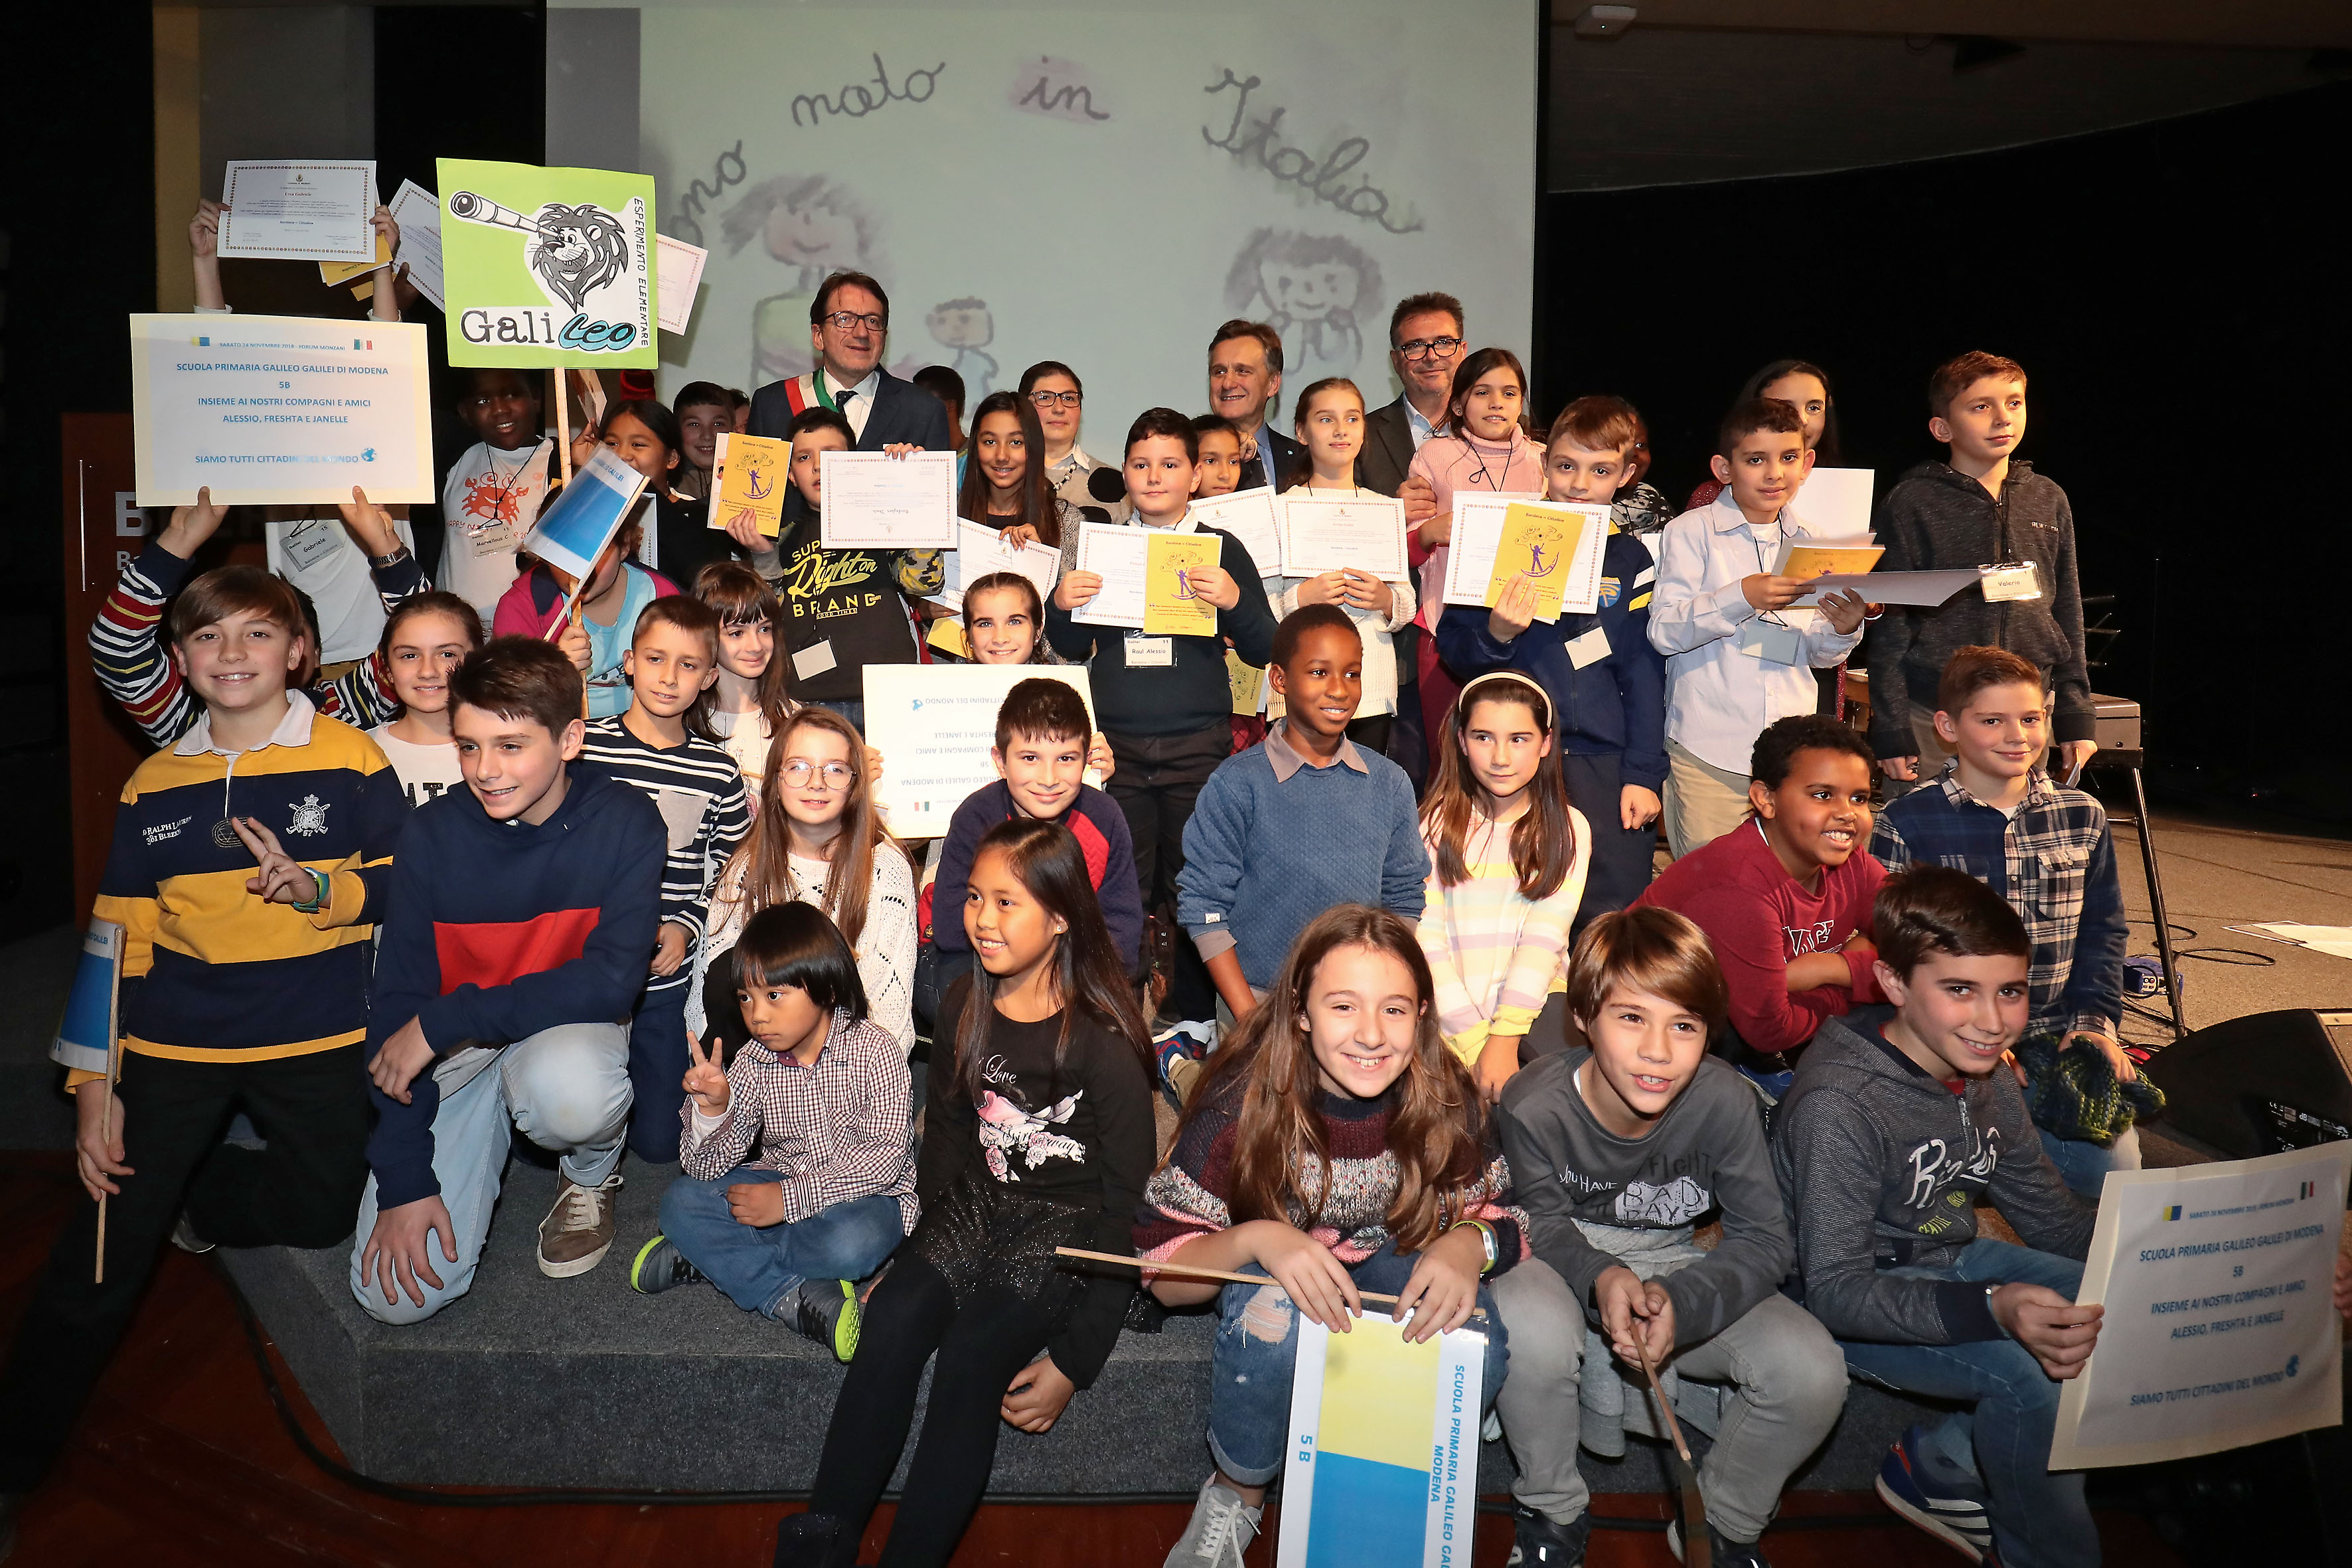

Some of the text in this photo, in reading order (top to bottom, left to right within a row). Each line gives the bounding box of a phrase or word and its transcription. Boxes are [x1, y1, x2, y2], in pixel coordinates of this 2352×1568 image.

[669, 52, 1425, 248] ono nato in Italia
[634, 198, 649, 346] ESPERIMENTO ELEMENTARE
[263, 364, 300, 372] GALILEO
[303, 538, 326, 552] Gabriele
[477, 537, 503, 547] Marvellous
[791, 540, 821, 562] SUP
[146, 835, 158, 845] 381
[147, 823, 172, 835] RALPH
[982, 1054, 1017, 1084] Love
[1648, 1150, 1710, 1180] FIGHT
[1579, 1174, 1618, 1193] HAVE
[1623, 1176, 1704, 1208] BAD
[2140, 1248, 2175, 1261] SCUOLA
[2178, 1243, 2220, 1257] PRIMARIA
[2223, 1237, 2256, 1252] GALILEO
[2258, 1232, 2284, 1247] GALILEI
[2292, 1224, 2323, 1240] MODENA
[2233, 1265, 2244, 1277] 5B
[2151, 1280, 2306, 1314] INSIEME AI NOSTRI COMPAGNI E AMICI
[2171, 1324, 2208, 1339] ALESSIO,
[2211, 1317, 2245, 1333] FRESHTA
[2254, 1310, 2285, 1325] JANELLE
[2130, 1372, 2284, 1406] SIAMO TUTTI CITTADINI DEL MONDO
[1299, 1435, 1312, 1462] 5 B
[1431, 1445, 1443, 1502] MODENA
[1441, 1365, 1464, 1568] SCUOLA PRIMARIA GALILEO GAL
